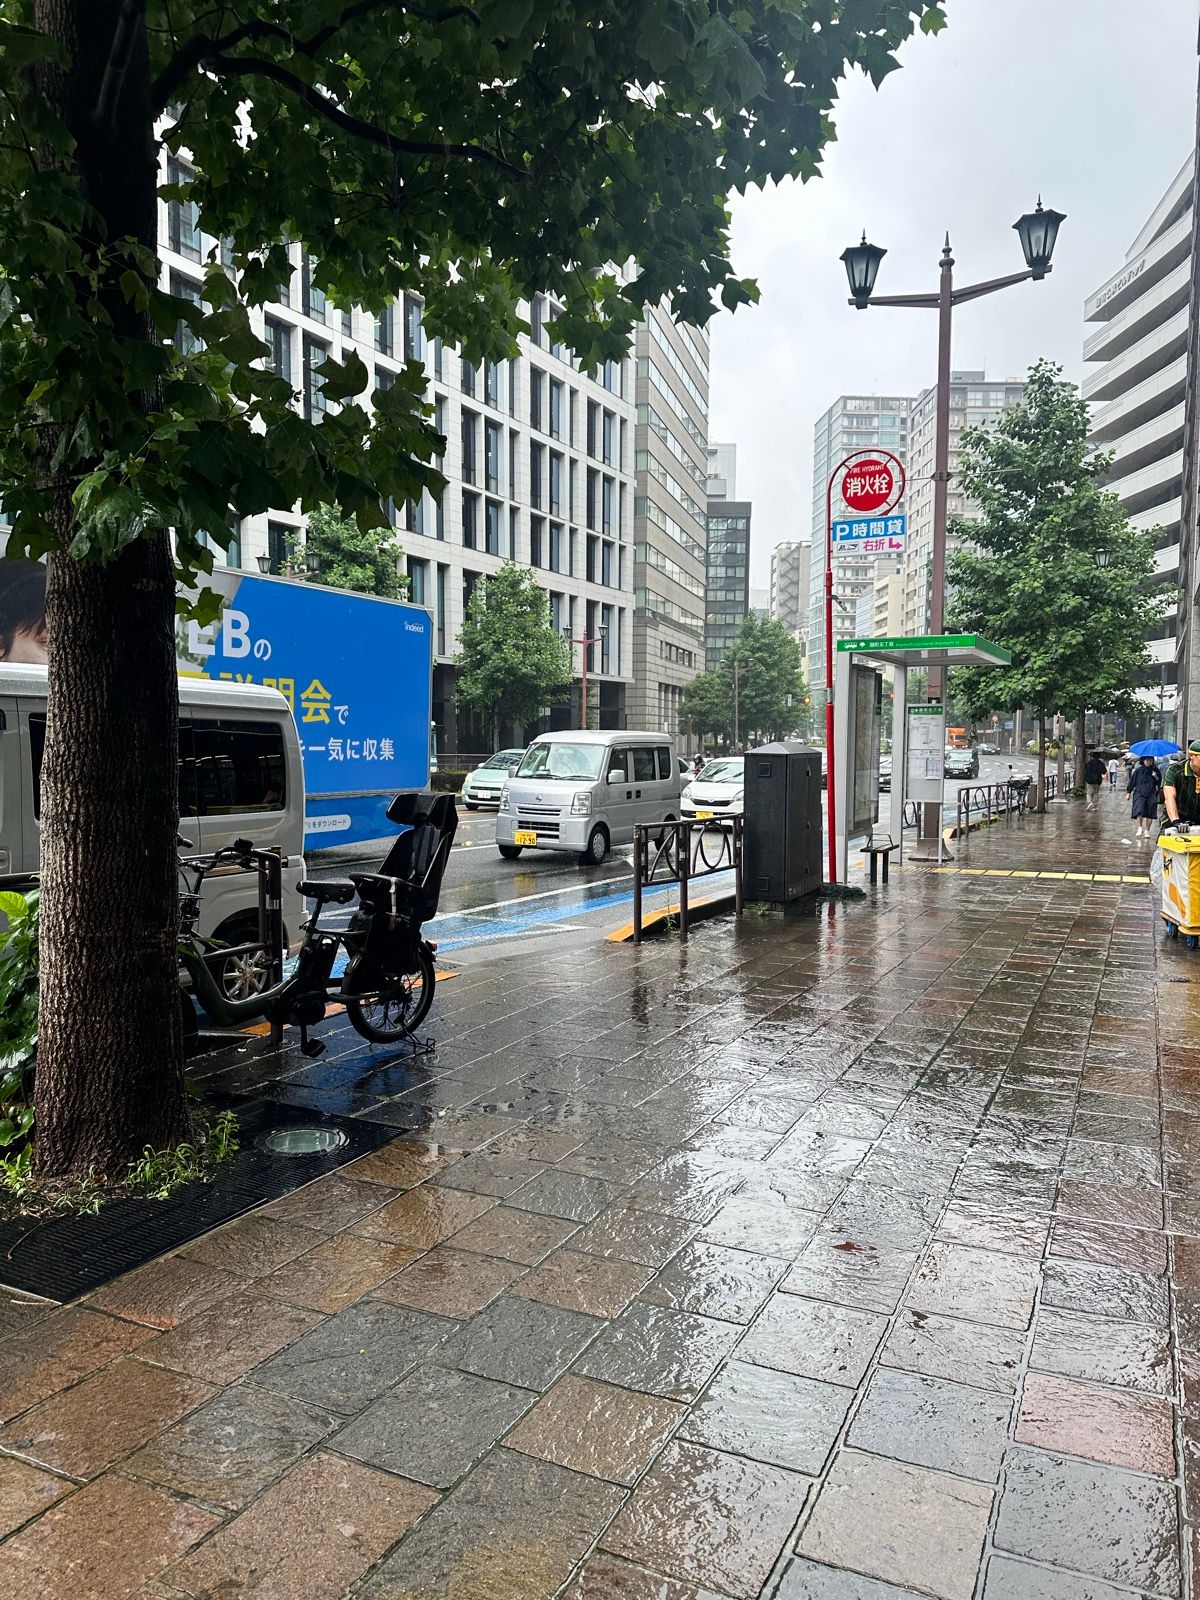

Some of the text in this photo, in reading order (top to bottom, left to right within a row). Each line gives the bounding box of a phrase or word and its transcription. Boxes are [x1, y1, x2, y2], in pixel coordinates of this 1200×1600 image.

[849, 464, 885, 474] FIRE HYDRANT
[846, 472, 890, 498] 消火栓
[863, 538, 885, 552] 右折
[404, 620, 424, 633] indeed
[175, 608, 272, 661] EBの
[304, 819, 347, 829] リをダウンロード
